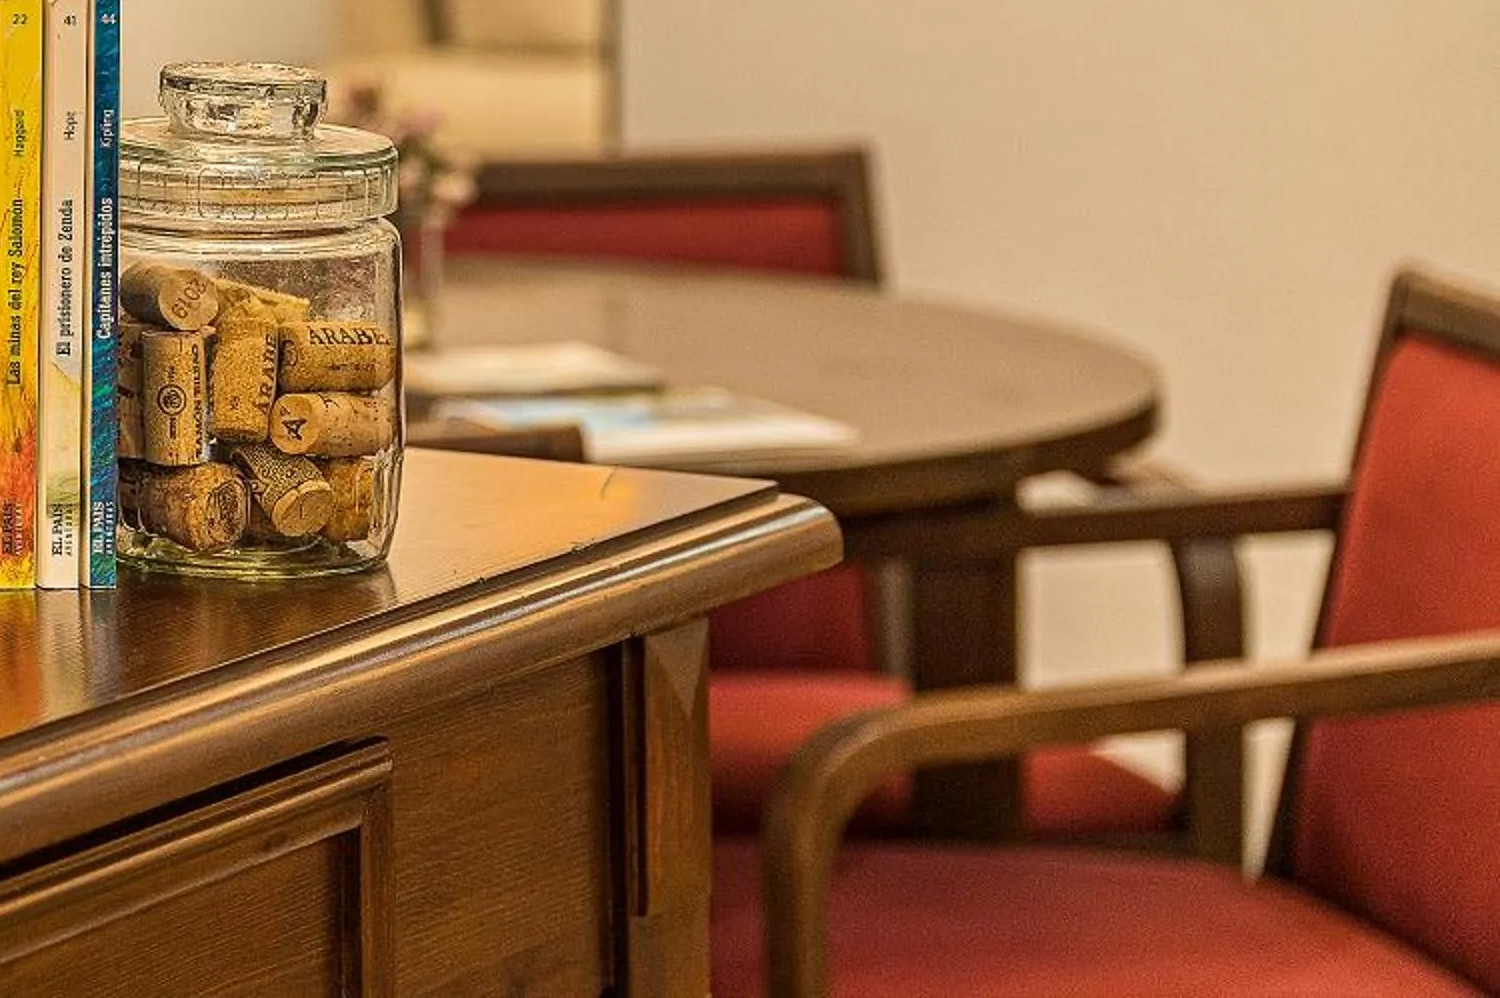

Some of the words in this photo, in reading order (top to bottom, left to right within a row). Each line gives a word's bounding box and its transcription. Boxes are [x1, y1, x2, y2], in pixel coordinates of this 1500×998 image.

[12, 13, 28, 24] 22
[12, 109, 27, 156] Haggard
[63, 111, 77, 140] Hope
[100, 109, 116, 148] Kipling
[57, 198, 73, 241] Zenda
[57, 246, 72, 262] de
[10, 262, 27, 285] rey
[7, 289, 23, 309] del
[56, 267, 74, 337] prisionero
[96, 271, 113, 339] Capitanes
[8, 315, 21, 355] minas
[56, 342, 71, 355] El
[7, 362, 21, 385] Las
[51, 503, 63, 534] PAIS
[51, 537, 63, 556] EL
